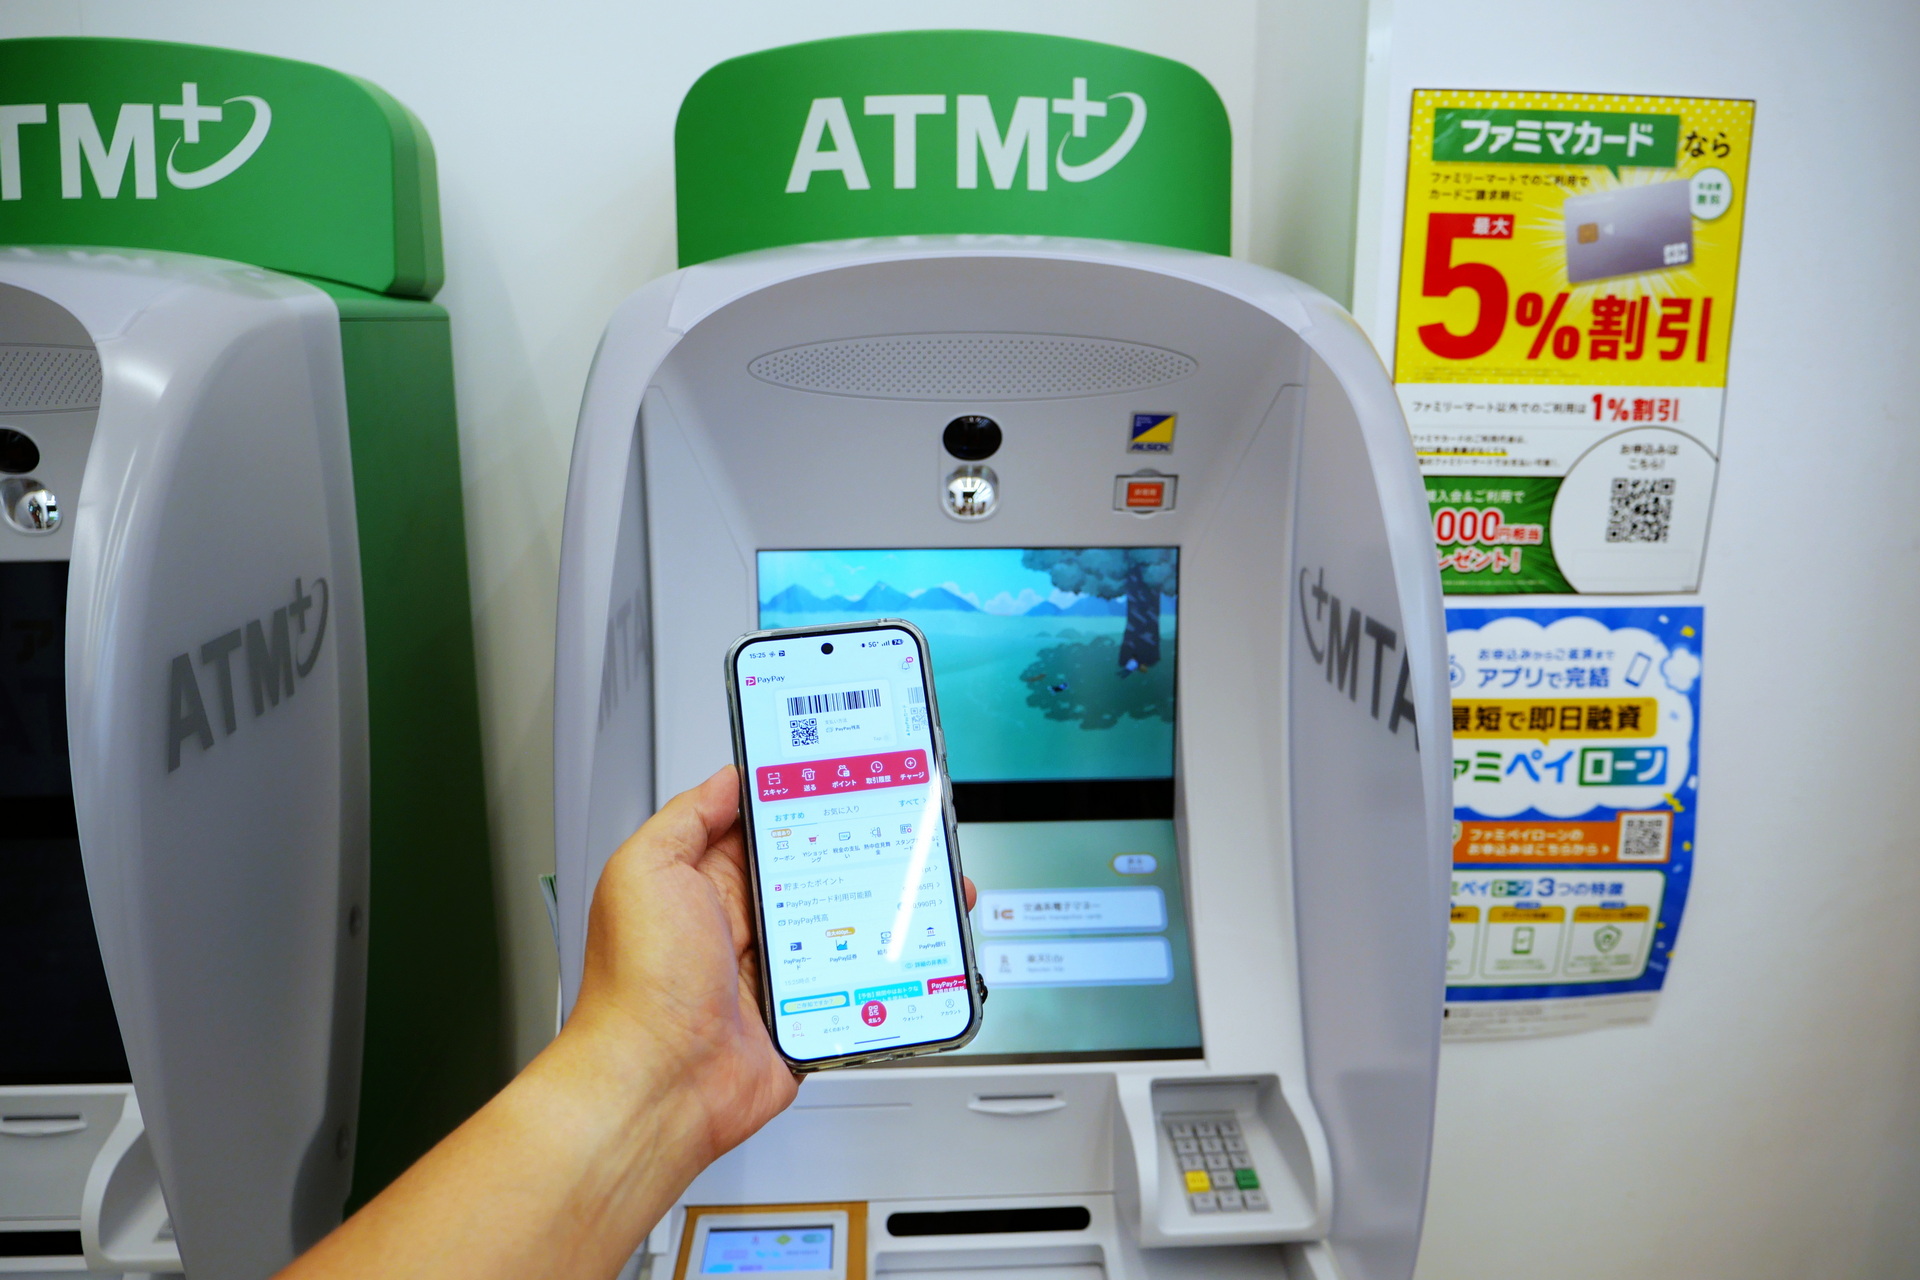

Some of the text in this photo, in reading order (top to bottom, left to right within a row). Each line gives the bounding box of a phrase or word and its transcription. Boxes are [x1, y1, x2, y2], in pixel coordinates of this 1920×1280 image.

[1460, 120, 1732, 158] ファミマカード なら
[1472, 217, 1511, 236] 最大
[757, 675, 786, 684] PayPay
[1478, 666, 1610, 689] アプリで完結
[900, 771, 925, 781] チャージ
[803, 783, 817, 792] 送る
[832, 778, 857, 788] ポイント
[763, 787, 789, 796] スキャン
[898, 797, 920, 807] すべて
[823, 805, 860, 816] お気に入り
[774, 811, 805, 822] おすすめ
[773, 855, 796, 863] クーポン
[784, 876, 844, 891] 貯まったポイント
[786, 890, 872, 909] PayPayカード利用可能額
[788, 913, 829, 926] PayPay残高
